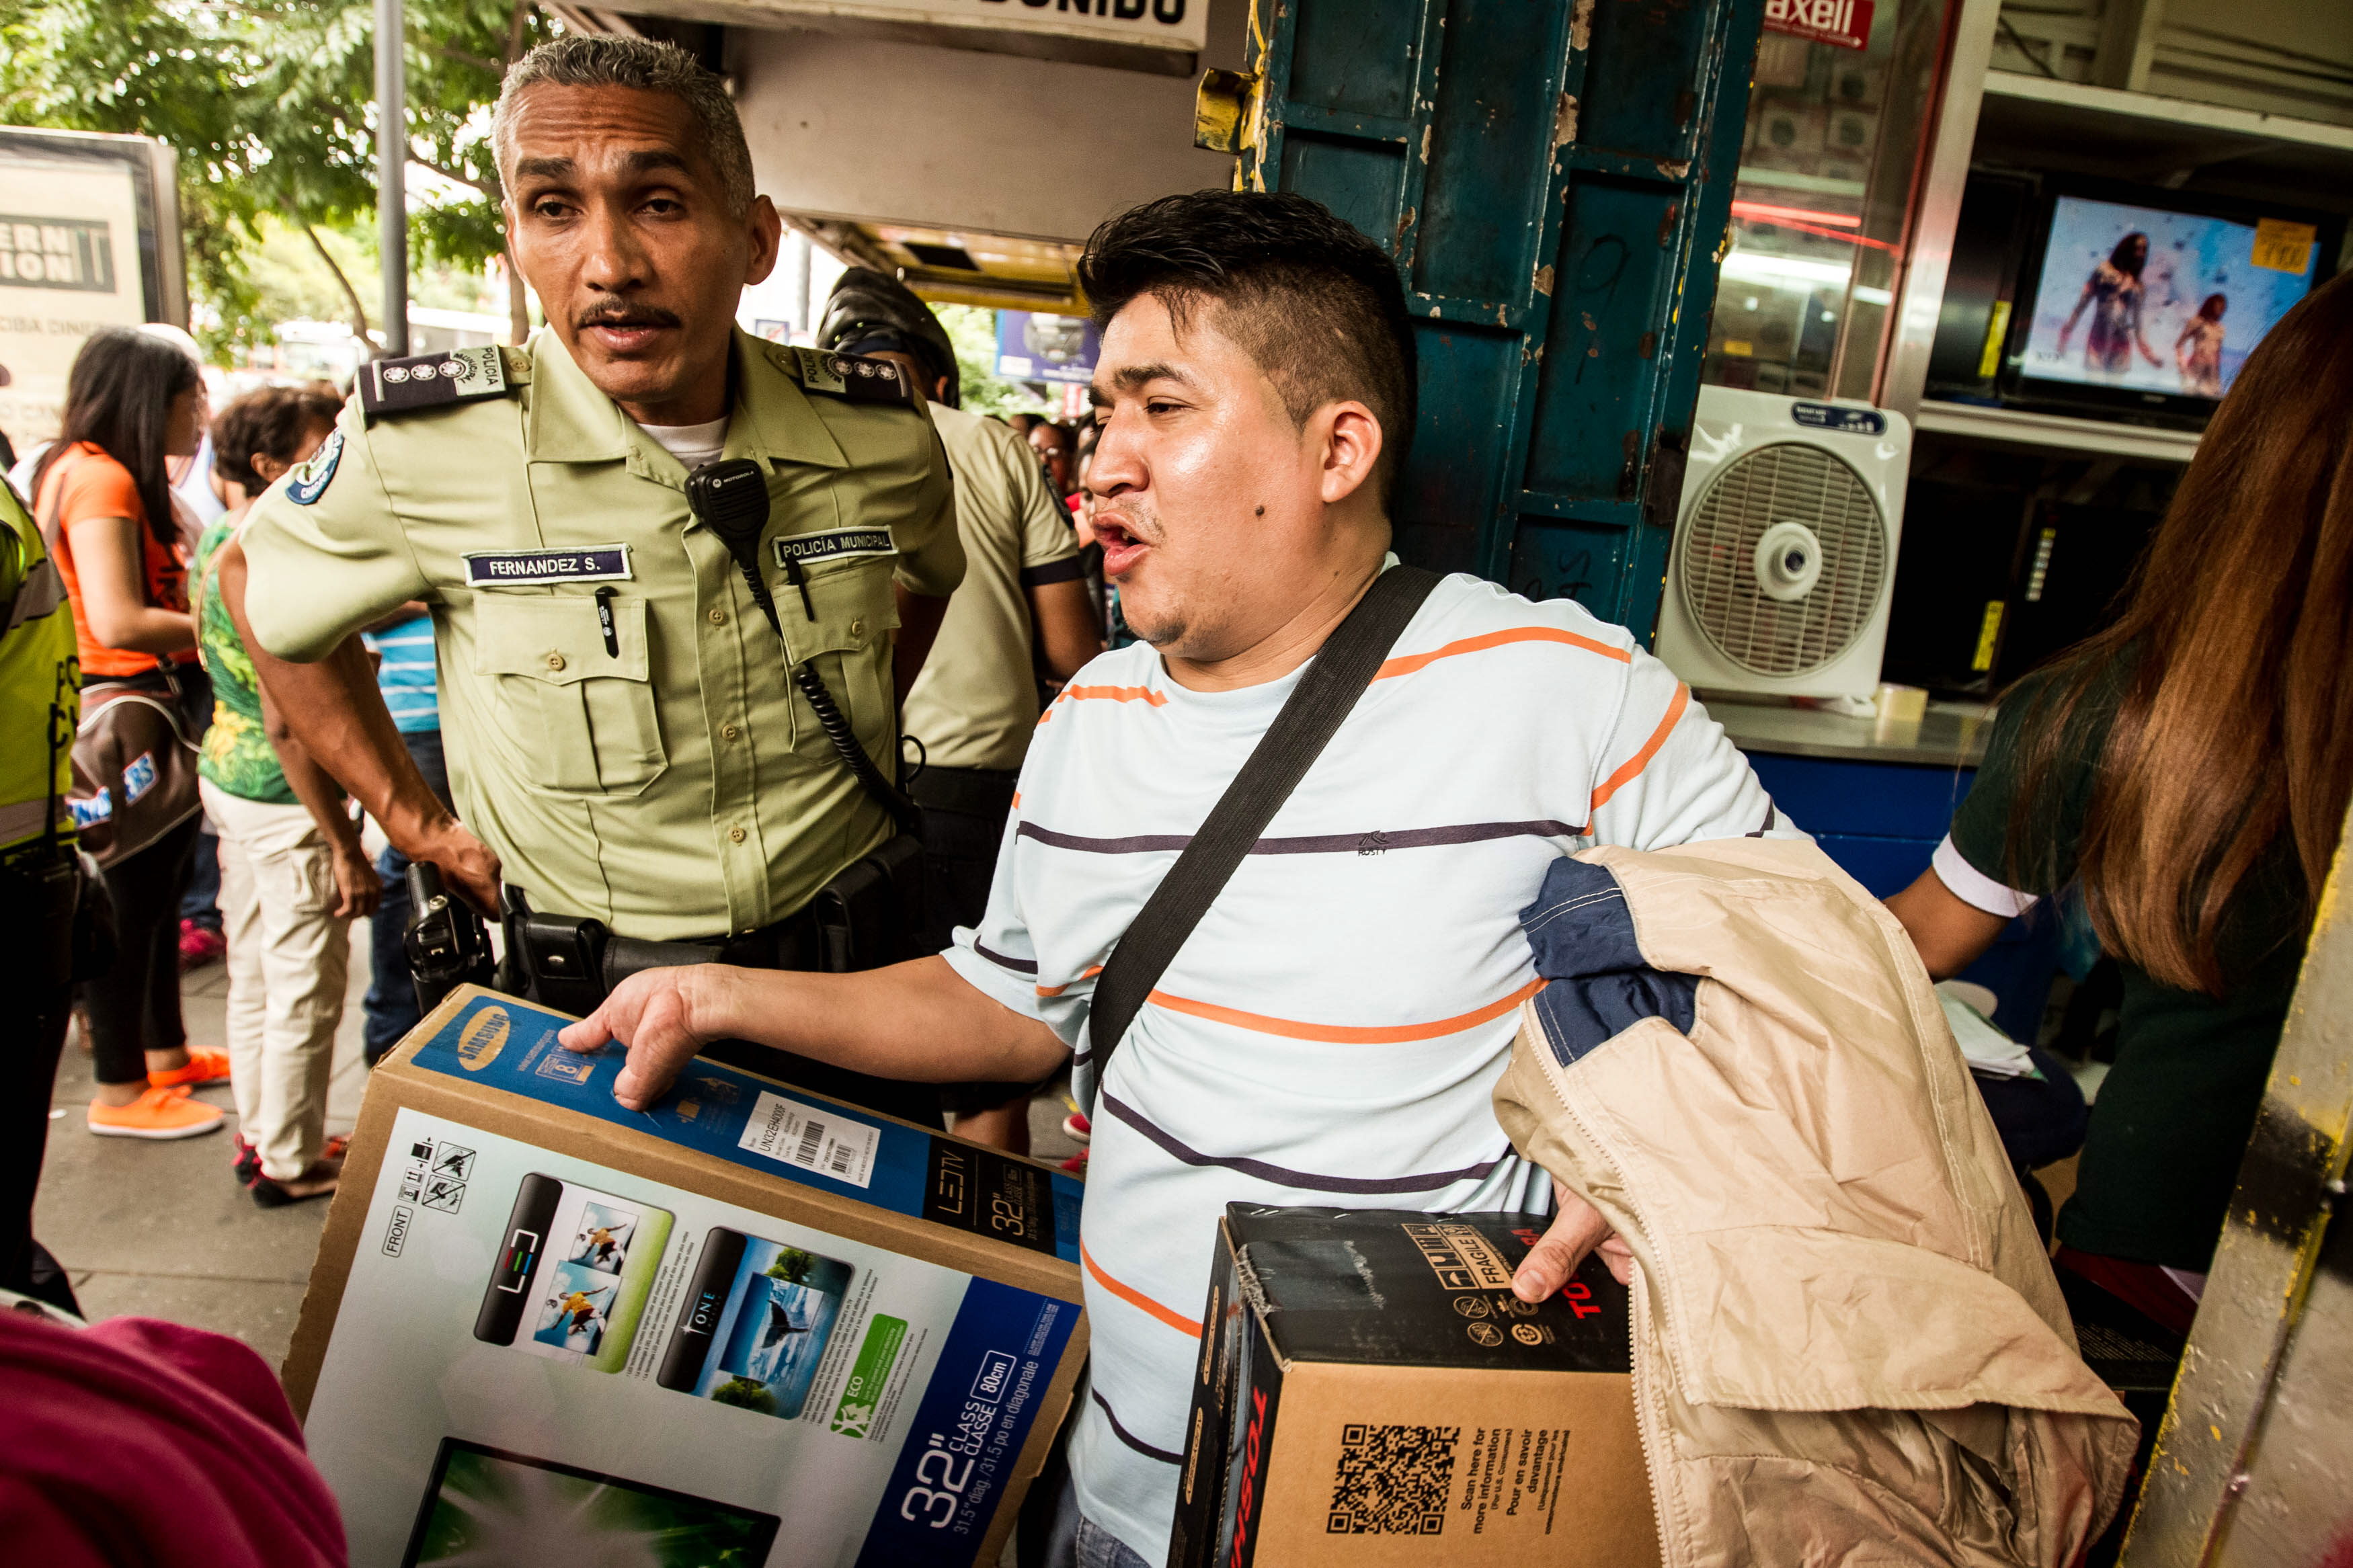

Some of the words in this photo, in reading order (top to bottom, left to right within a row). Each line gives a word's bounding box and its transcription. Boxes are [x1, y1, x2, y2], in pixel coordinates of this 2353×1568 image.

[480, 347, 500, 385] POLICIA
[723, 470, 754, 483] MOTOROLA
[783, 536, 836, 558] POLICÍA
[840, 532, 890, 549] MUNICIPAL
[489, 558, 579, 575] FERNANDEZ
[584, 556, 600, 571] S.
[458, 1013, 510, 1061] SAMSUNG
[941, 1149, 965, 1169] TV
[938, 1169, 964, 1214] LED
[387, 1211, 409, 1253] FRONT
[497, 1229, 539, 1294] LED
[1459, 1238, 1505, 1285] FRAGILE
[1511, 1229, 1602, 1319] TOBA
[696, 1291, 716, 1325] ONE
[847, 1374, 865, 1398] ECO
[980, 1361, 1007, 1394] 80cm
[1006, 1360, 1039, 1414] diagonale
[949, 1401, 982, 1452] CLASS
[964, 1407, 997, 1456] CLASSE
[994, 1429, 1012, 1446] po
[1000, 1413, 1017, 1430] en
[1472, 1428, 1486, 1446] for
[1466, 1448, 1482, 1477] here
[1478, 1428, 1501, 1499] information
[1518, 1429, 1533, 1467] savoir
[1527, 1430, 1548, 1493] davantage
[901, 1432, 975, 1529] 32"
[1515, 1469, 1525, 1485] en
[1460, 1479, 1476, 1510] Scan
[1506, 1487, 1521, 1516] Pour
[1474, 1502, 1487, 1534] more
